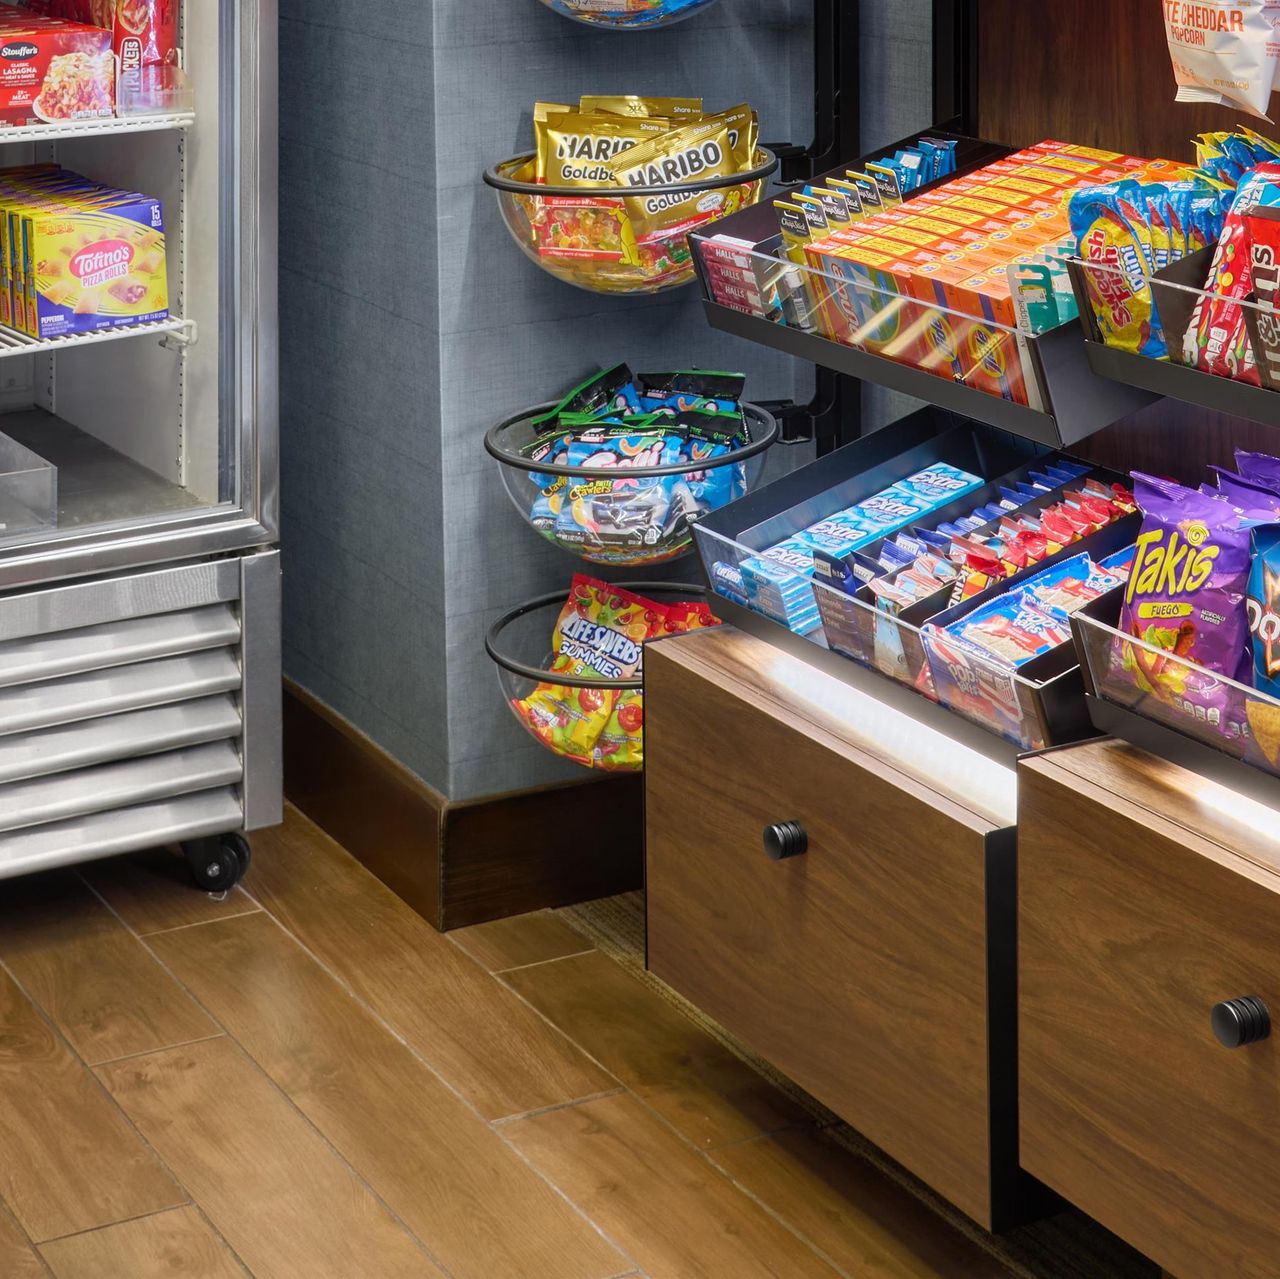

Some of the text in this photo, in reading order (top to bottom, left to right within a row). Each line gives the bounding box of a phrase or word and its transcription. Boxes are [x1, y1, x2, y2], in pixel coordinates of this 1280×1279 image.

[1, 45, 38, 57] Stouffer's
[75, 246, 130, 273] Totino's
[82, 264, 127, 288] PIZZA ROLLS
[1126, 528, 1220, 604] Takis
[1151, 604, 1180, 616] FUEGO
